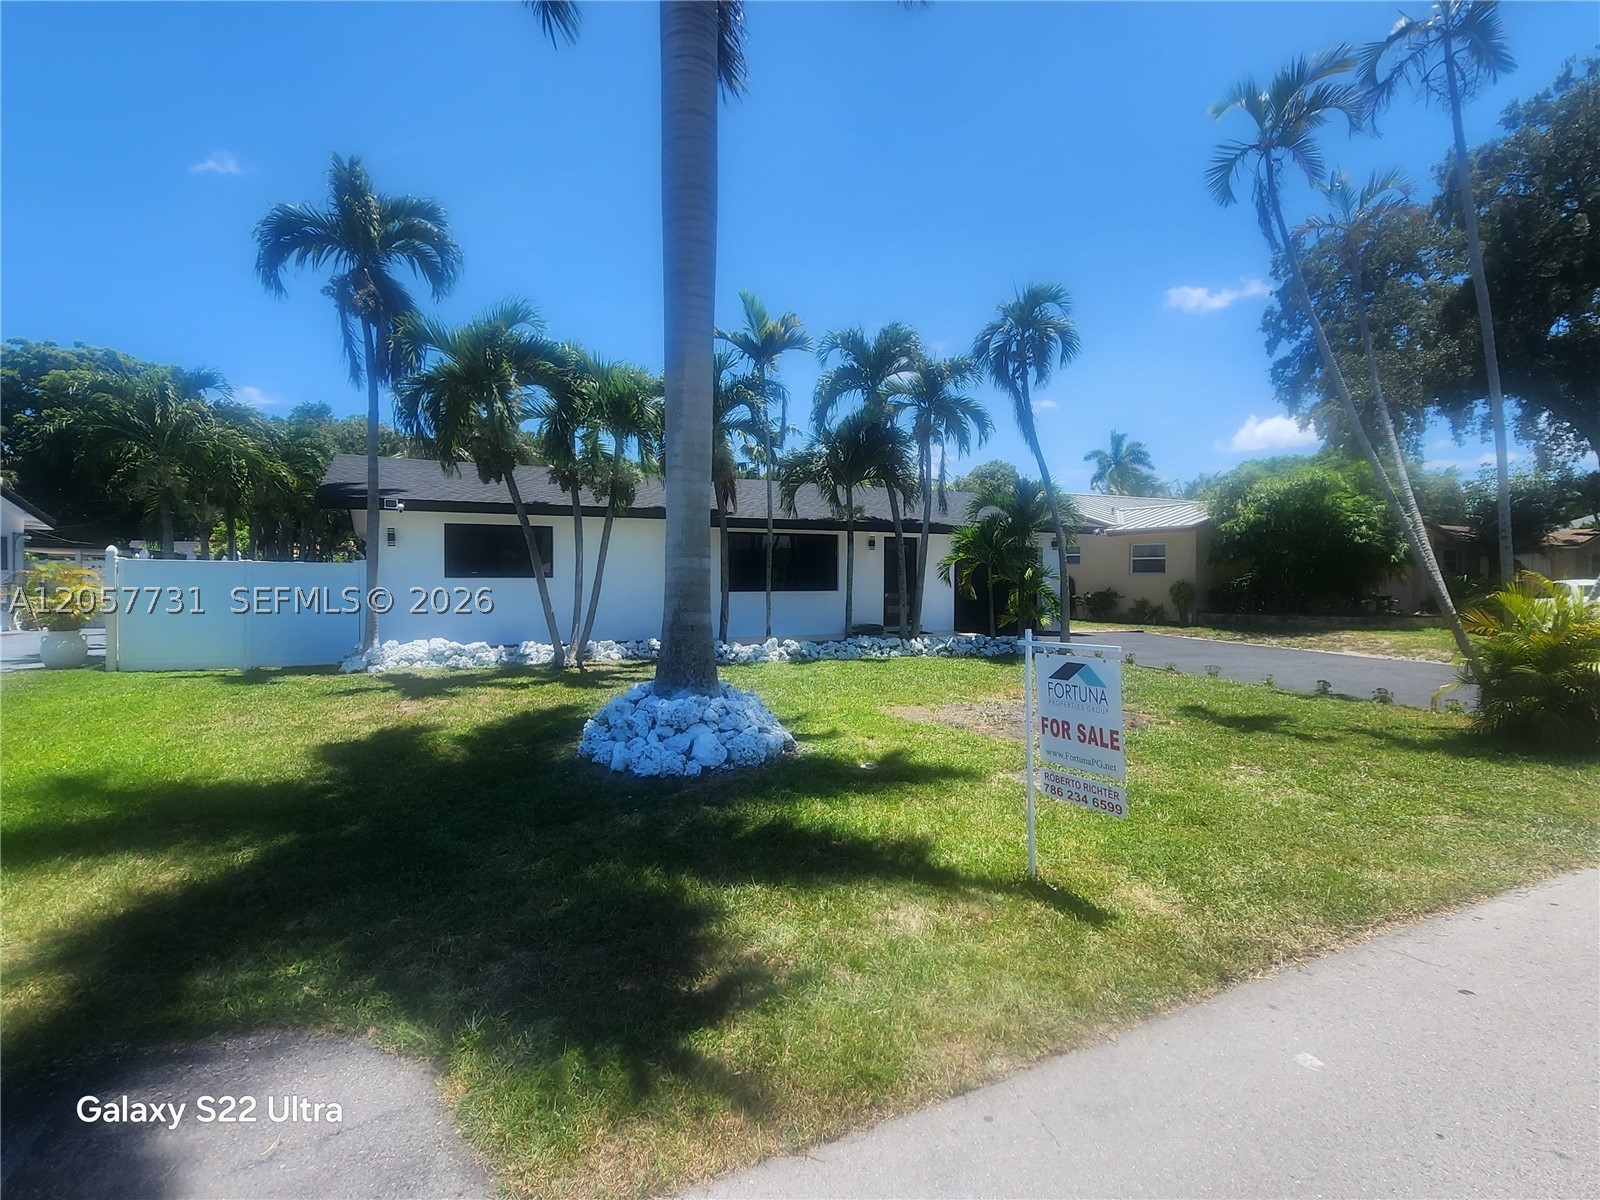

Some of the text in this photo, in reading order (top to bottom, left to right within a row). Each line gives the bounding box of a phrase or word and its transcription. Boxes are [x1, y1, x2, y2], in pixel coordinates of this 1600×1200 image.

[1047, 682, 1109, 706] FORTUNA
[1048, 699, 1109, 715] PROPERTIES GROUP
[1041, 716, 1120, 751] FOR SALE
[1045, 749, 1117, 772] www.FortunaPG.net
[1043, 783, 1123, 815] 786 234 6599
[1044, 772, 1120, 801] ROBERTO RICHTER
